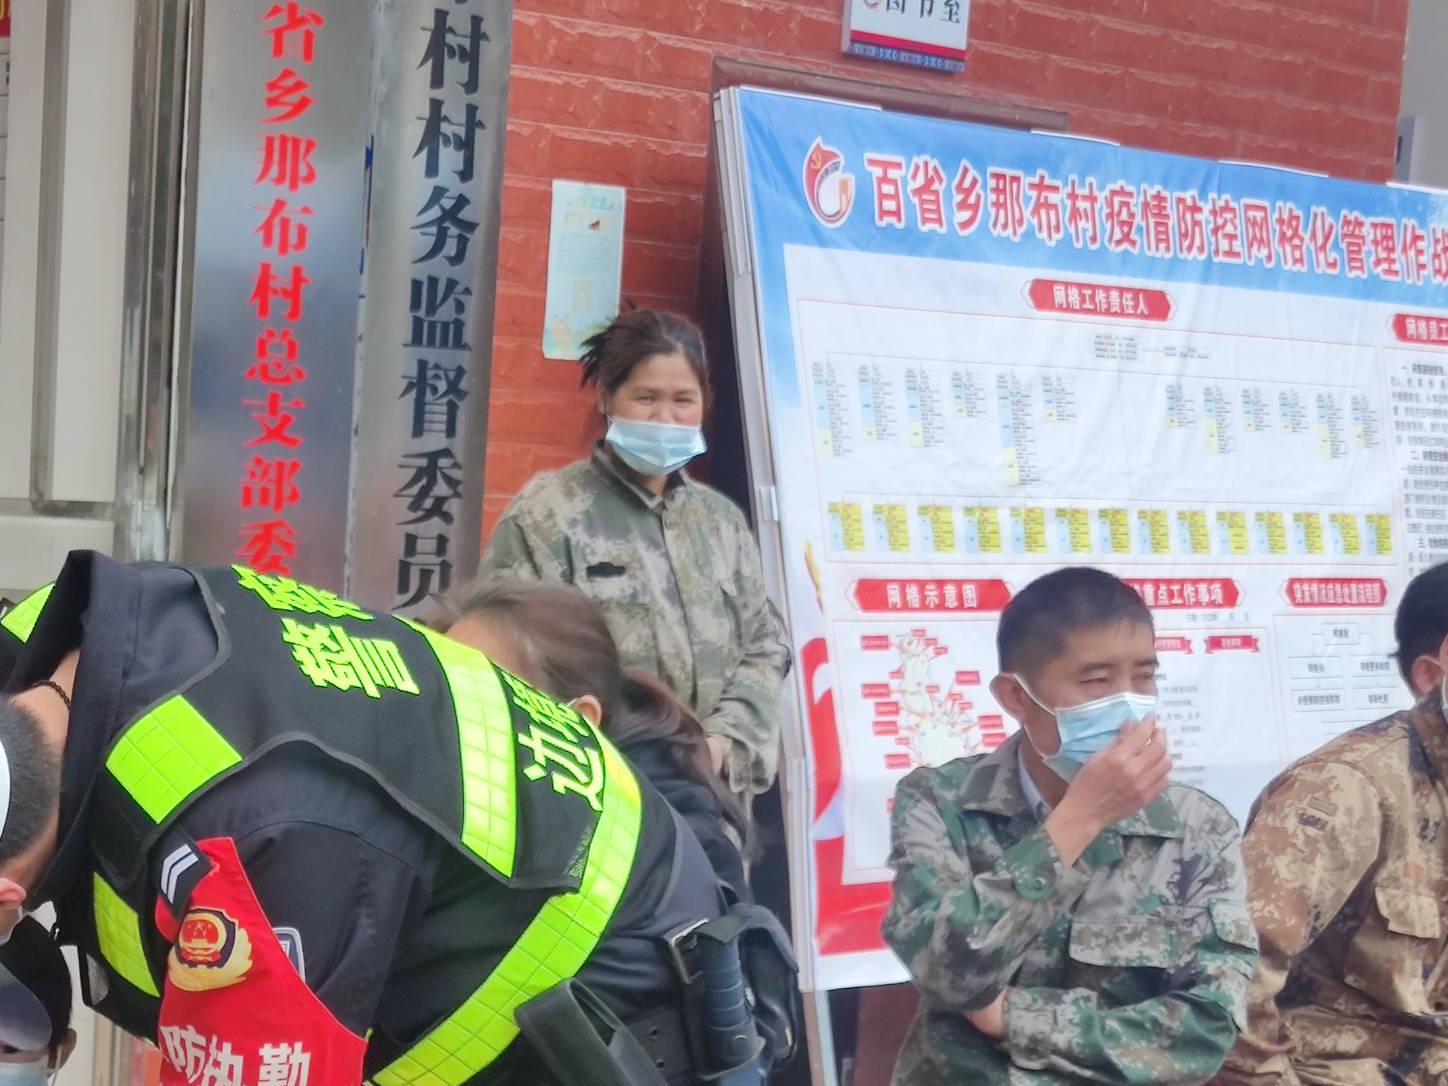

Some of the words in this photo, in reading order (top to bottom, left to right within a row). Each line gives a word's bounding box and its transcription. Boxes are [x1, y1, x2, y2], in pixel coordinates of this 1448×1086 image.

[236, 0, 326, 576] 省乡那布村总支部委
[1053, 284, 1149, 316] 网格工作责任人
[886, 582, 978, 609] 网格示意图
